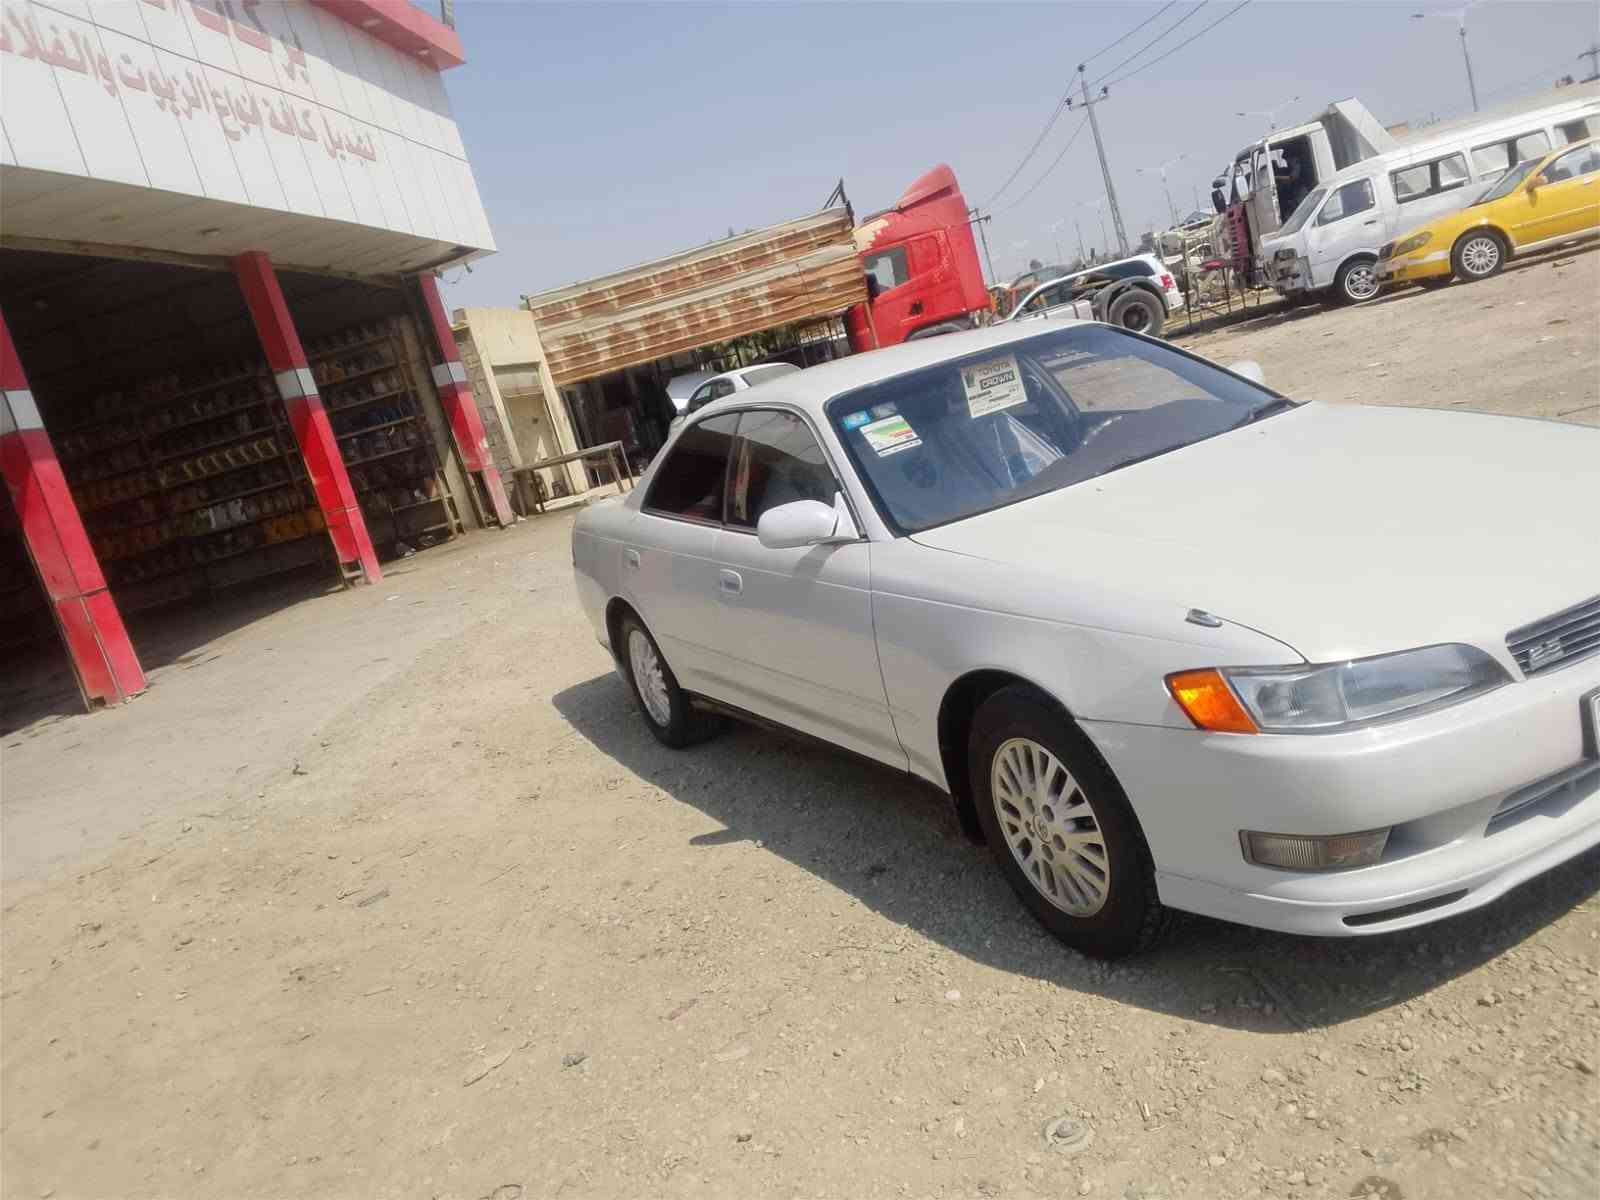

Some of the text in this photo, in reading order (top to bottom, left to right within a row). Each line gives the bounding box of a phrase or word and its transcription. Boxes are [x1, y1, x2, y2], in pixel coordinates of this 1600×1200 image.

[117, 53, 209, 120] الزيوت
[263, 95, 317, 142] كافة
[977, 360, 1011, 377] TOYOTA
[980, 370, 1014, 389] CROWN
